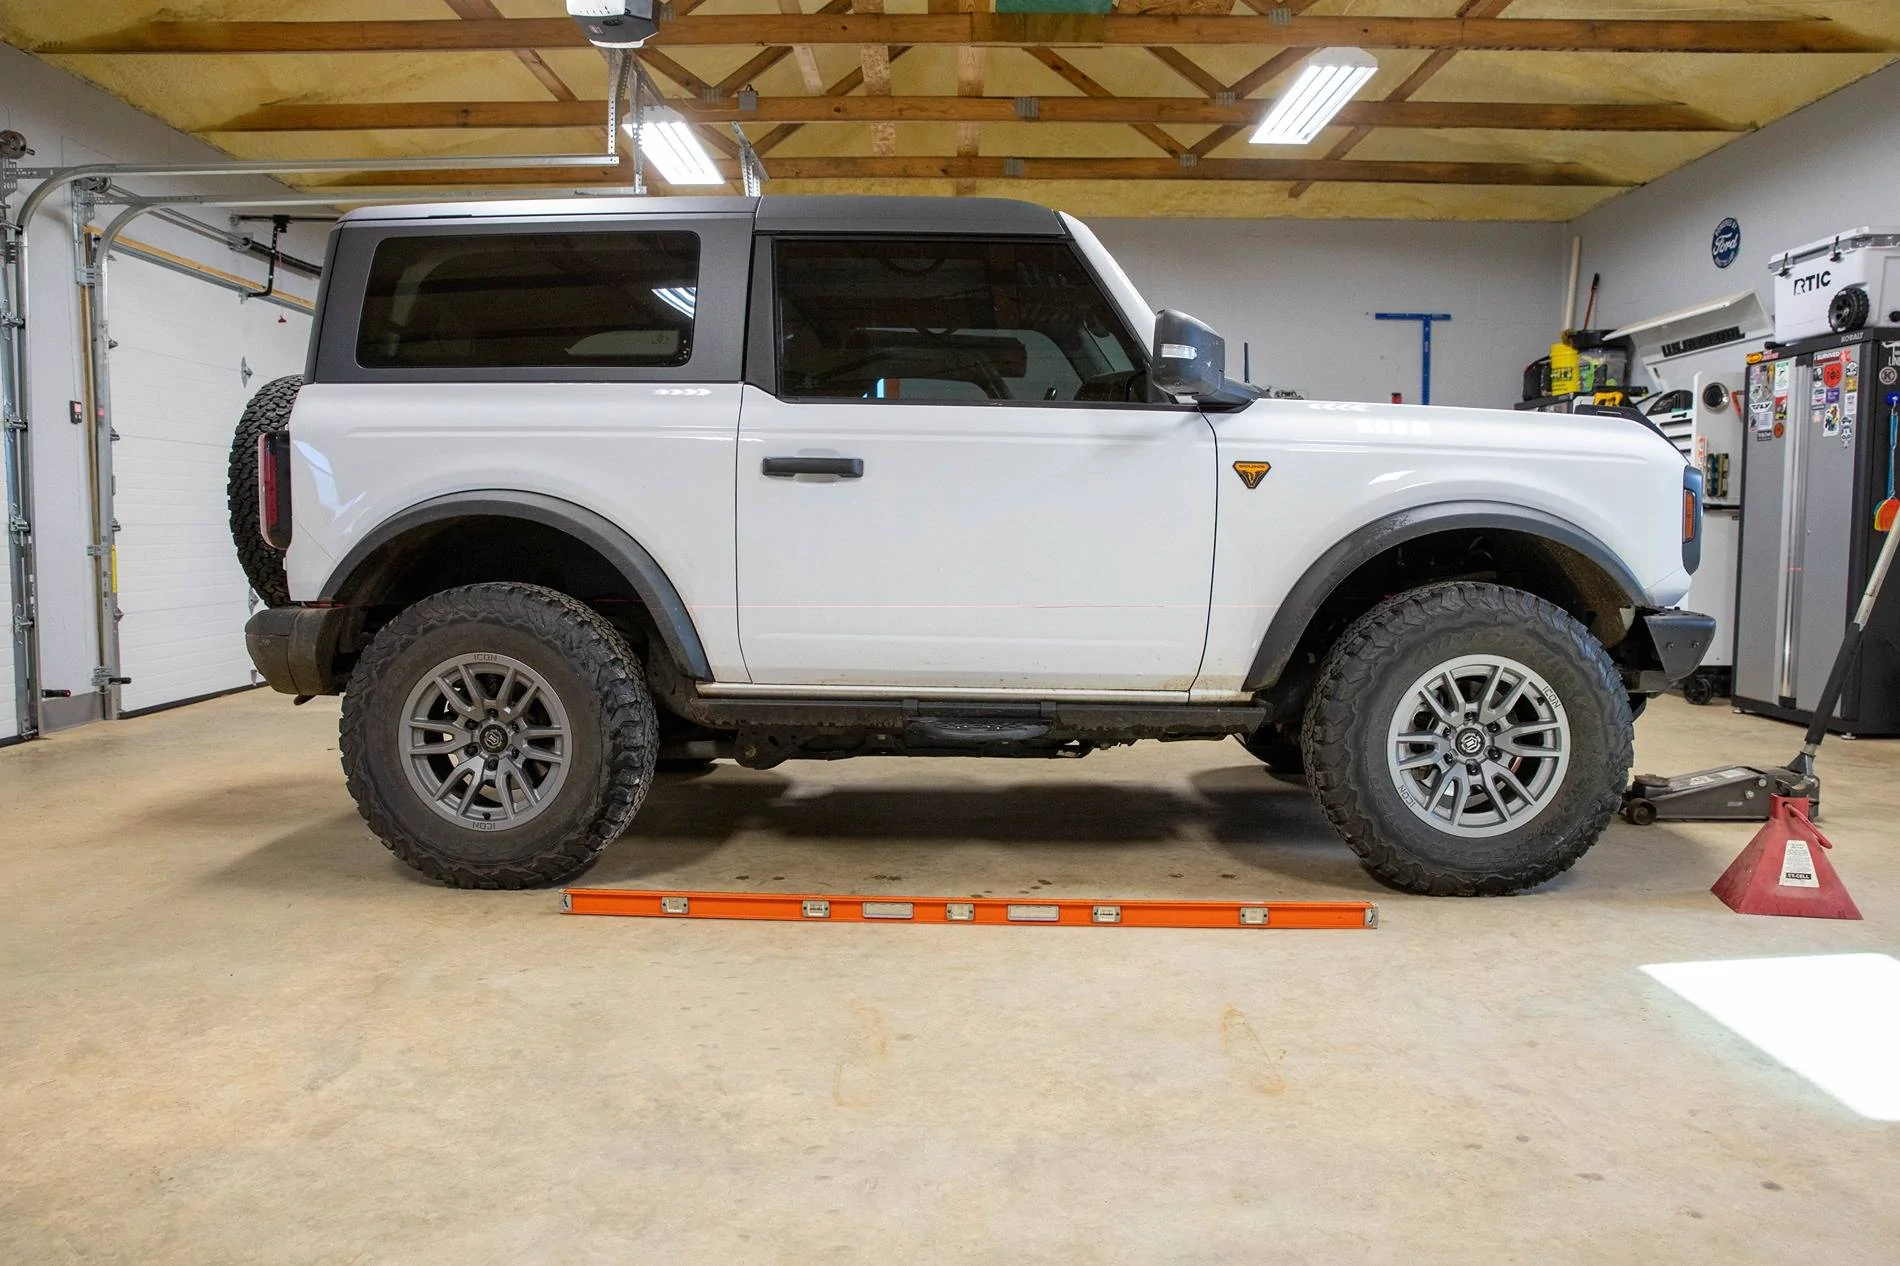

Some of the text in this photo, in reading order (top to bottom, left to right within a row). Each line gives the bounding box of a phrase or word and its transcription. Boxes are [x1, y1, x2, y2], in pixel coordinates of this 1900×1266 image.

[1712, 232, 1739, 256] Ford
[1794, 270, 1832, 296] RTIC
[473, 653, 498, 662] ICON
[1542, 685, 1562, 709] ICON
[1397, 784, 1416, 808] ICON
[472, 821, 496, 830] ICON
